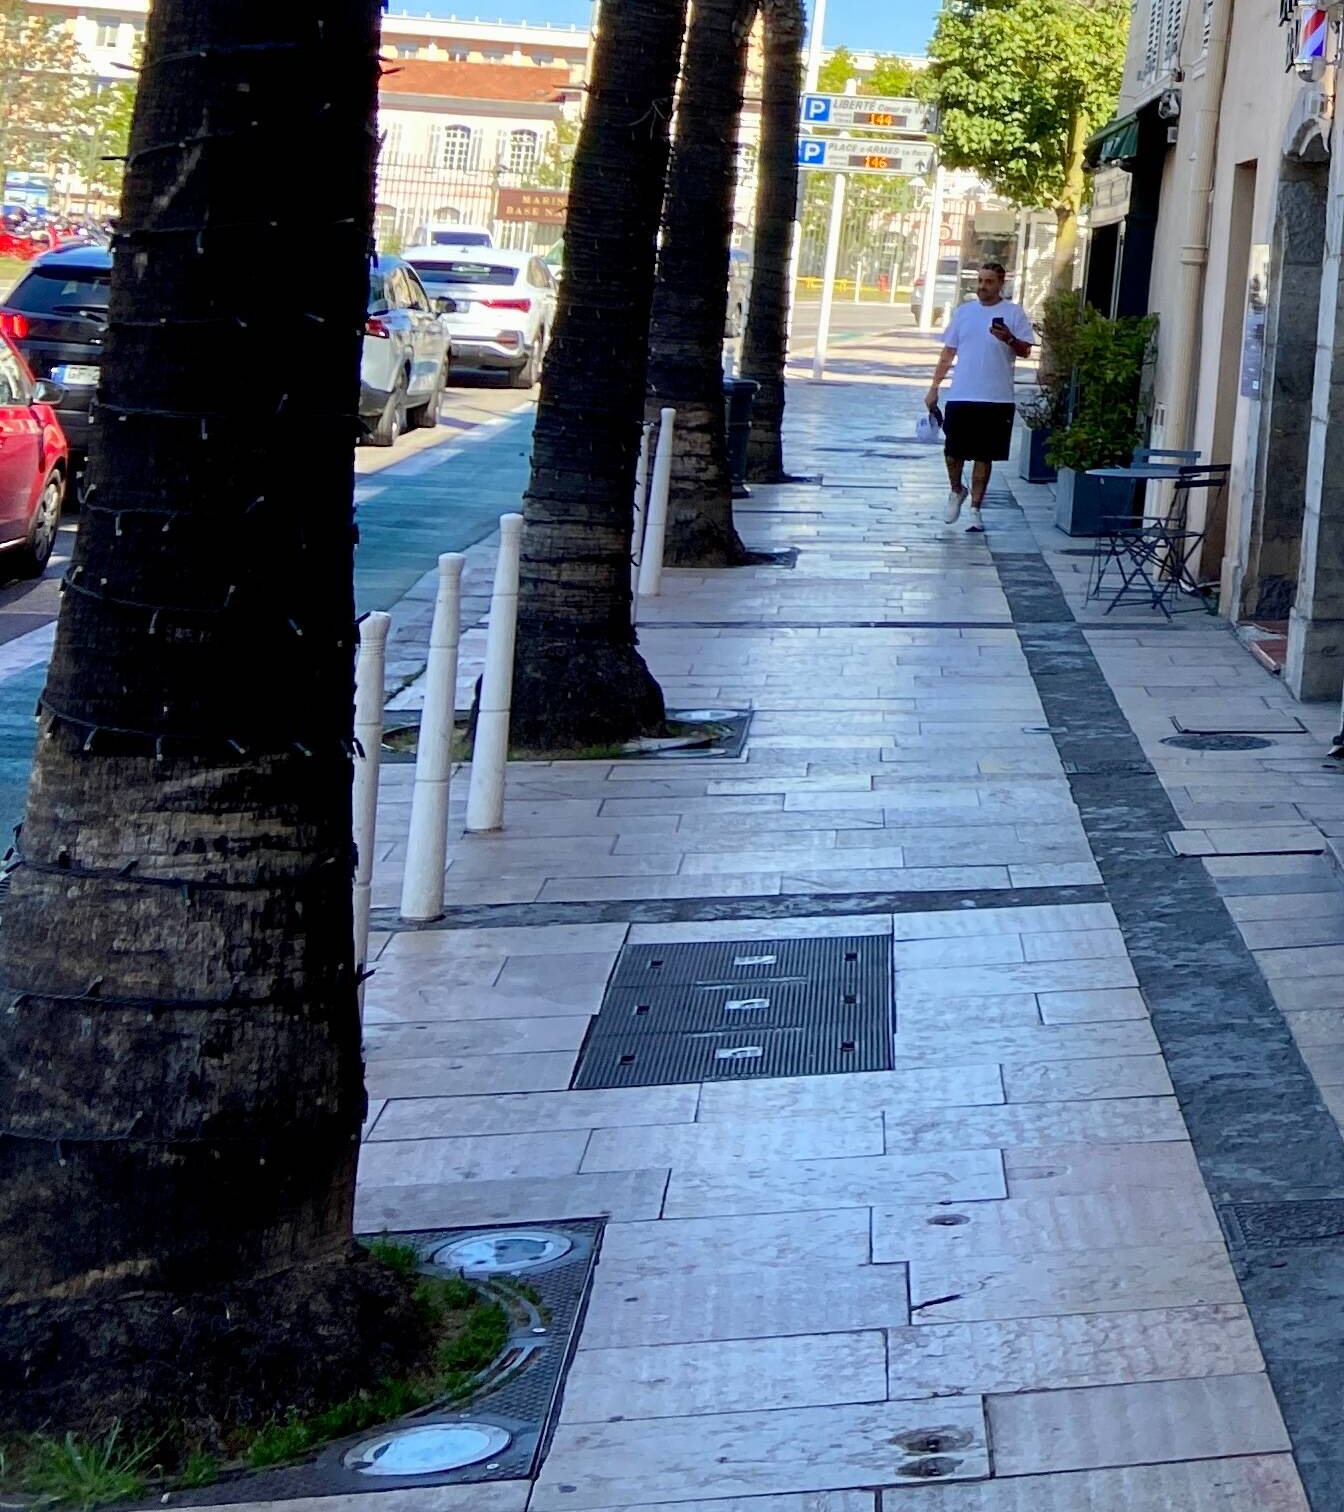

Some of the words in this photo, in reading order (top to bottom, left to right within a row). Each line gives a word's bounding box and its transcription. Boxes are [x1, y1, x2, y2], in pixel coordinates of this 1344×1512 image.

[809, 100, 826, 119] P
[833, 98, 876, 112] LIBERTÉ
[803, 143, 820, 162] P
[828, 142, 857, 153] PLACE
[522, 195, 567, 206] MARIN
